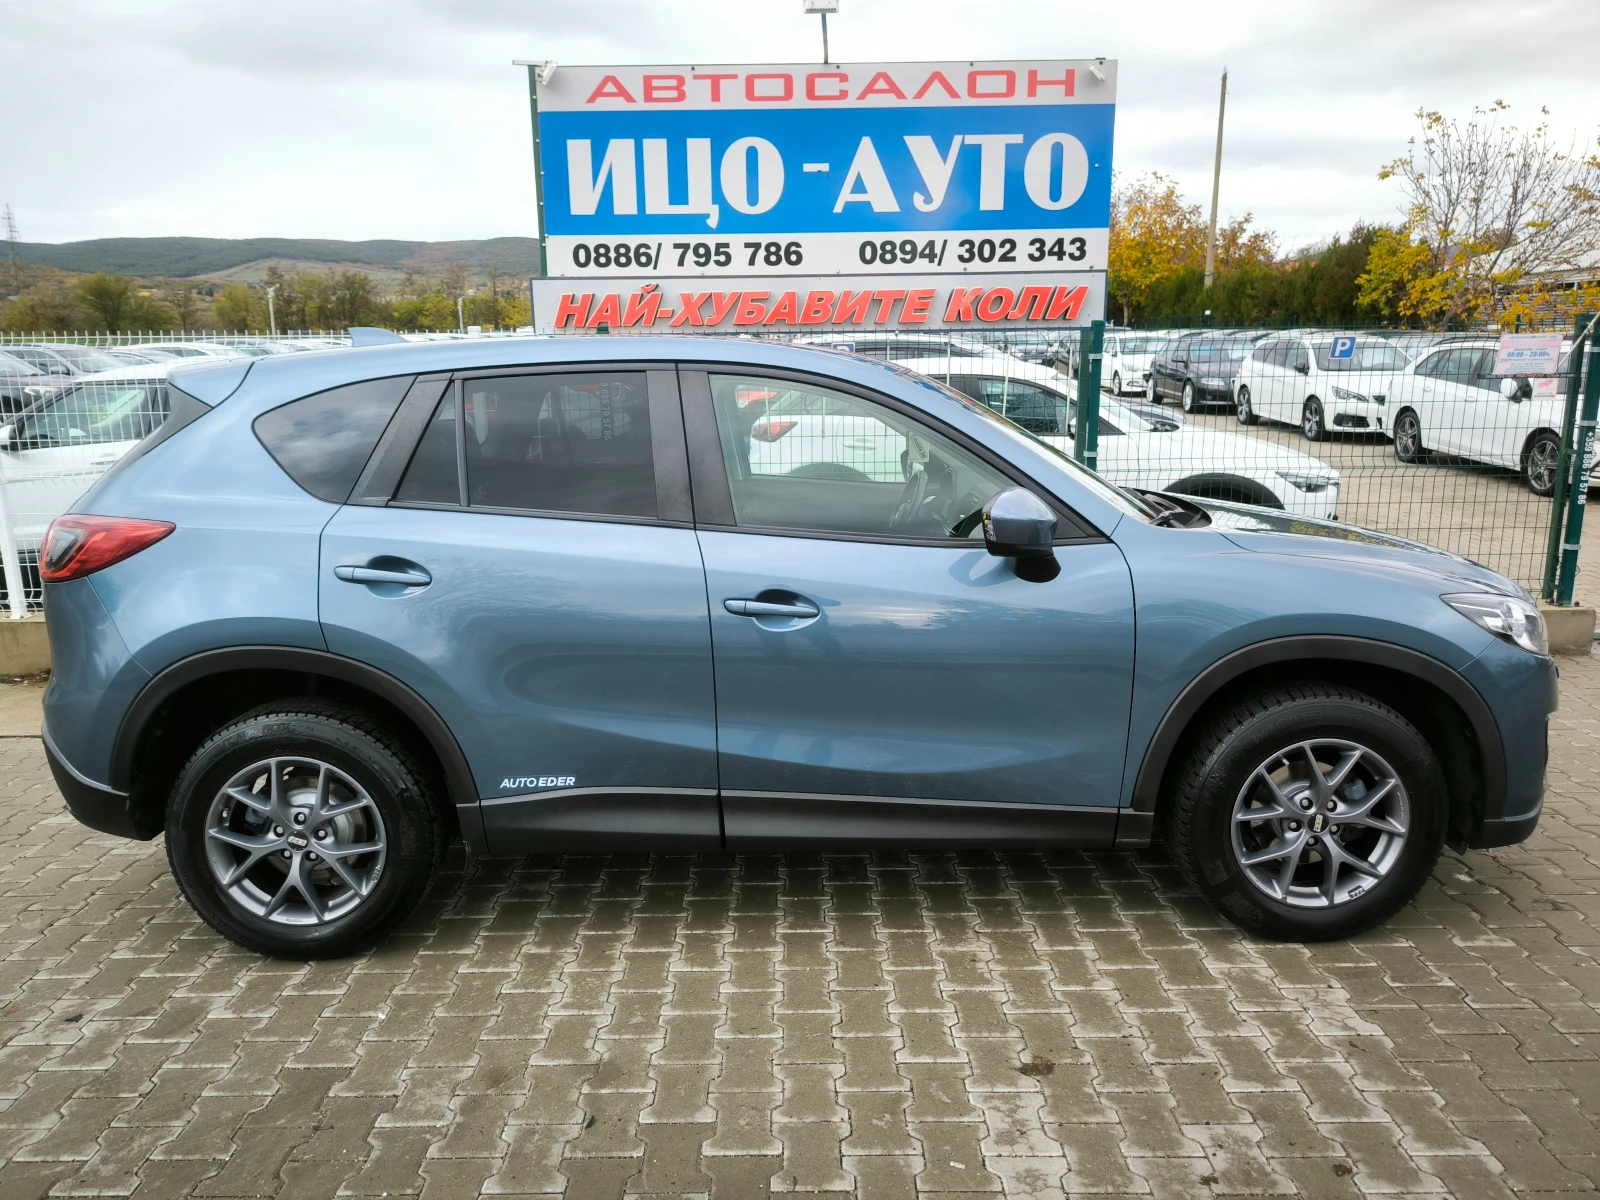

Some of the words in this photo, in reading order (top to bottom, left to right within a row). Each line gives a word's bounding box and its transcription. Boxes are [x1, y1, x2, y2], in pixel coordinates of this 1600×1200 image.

[586, 68, 1077, 104] АВТОСАЛОН
[572, 242, 662, 270] 0886/
[672, 242, 732, 268] 795
[743, 241, 803, 267] 786
[858, 239, 948, 267] 0894/
[957, 238, 1017, 264] 302
[1027, 236, 1087, 263] 343
[553, 284, 938, 329] НАЙ-ХУБАВИТЕ
[944, 285, 1089, 323] КОЛИ
[1334, 338, 1351, 357] P
[1584, 431, 1595, 452] +359
[1582, 453, 1592, 469] 886
[1580, 470, 1590, 481] 79
[1579, 482, 1588, 493] 57
[1577, 494, 1587, 505] 86
